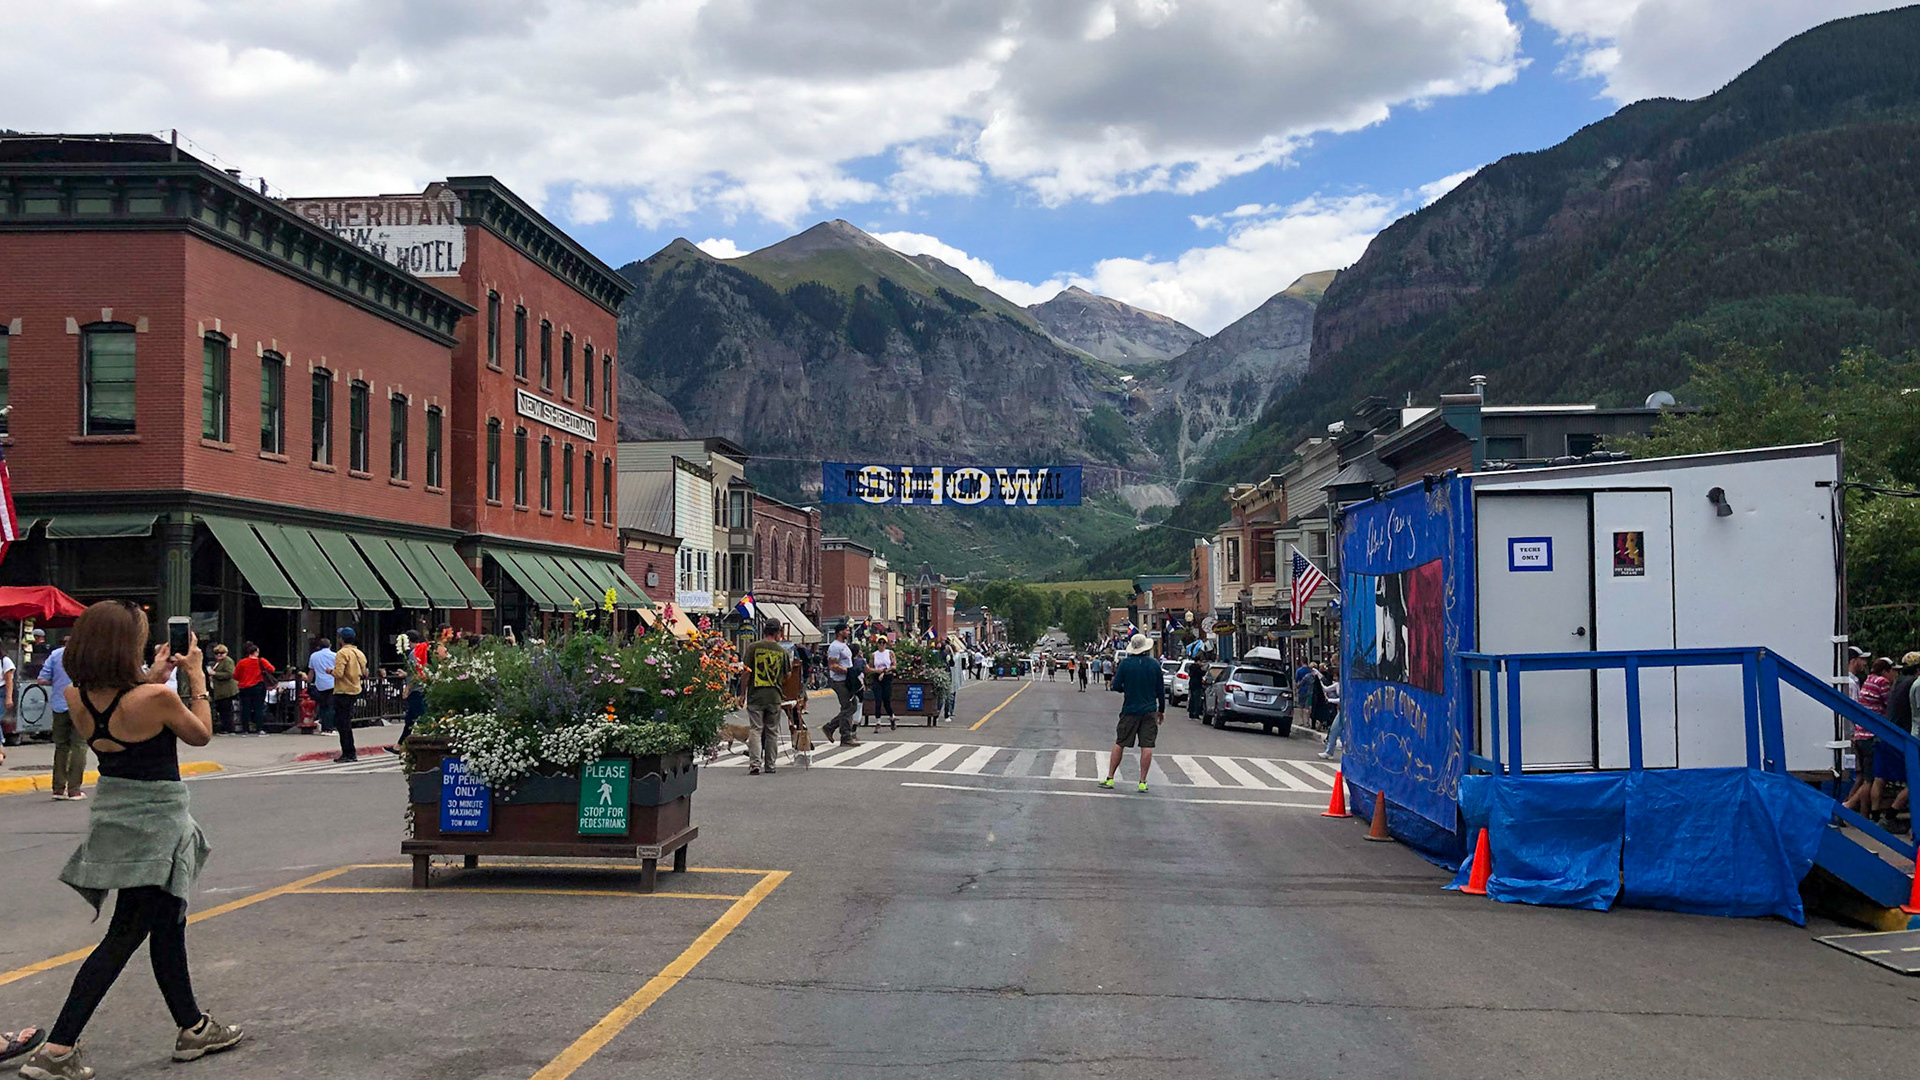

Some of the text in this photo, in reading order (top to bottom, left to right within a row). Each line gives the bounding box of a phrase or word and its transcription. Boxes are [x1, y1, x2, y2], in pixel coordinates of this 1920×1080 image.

[303, 201, 455, 227] SHERIDAN
[397, 240, 458, 273] HOTEL
[519, 393, 594, 437] NEW SHERIDAN
[845, 470, 1064, 500] TELLURIDE FILM FESTIVAL
[585, 765, 626, 779] PLEASE
[443, 774, 455, 785] BY
[454, 786, 477, 797] ONLY
[447, 799, 484, 809] 30 MINUTE
[449, 808, 482, 817] MAXIMUM
[583, 806, 624, 817] STOP FOR
[580, 817, 627, 829] PEDESTRIANS
